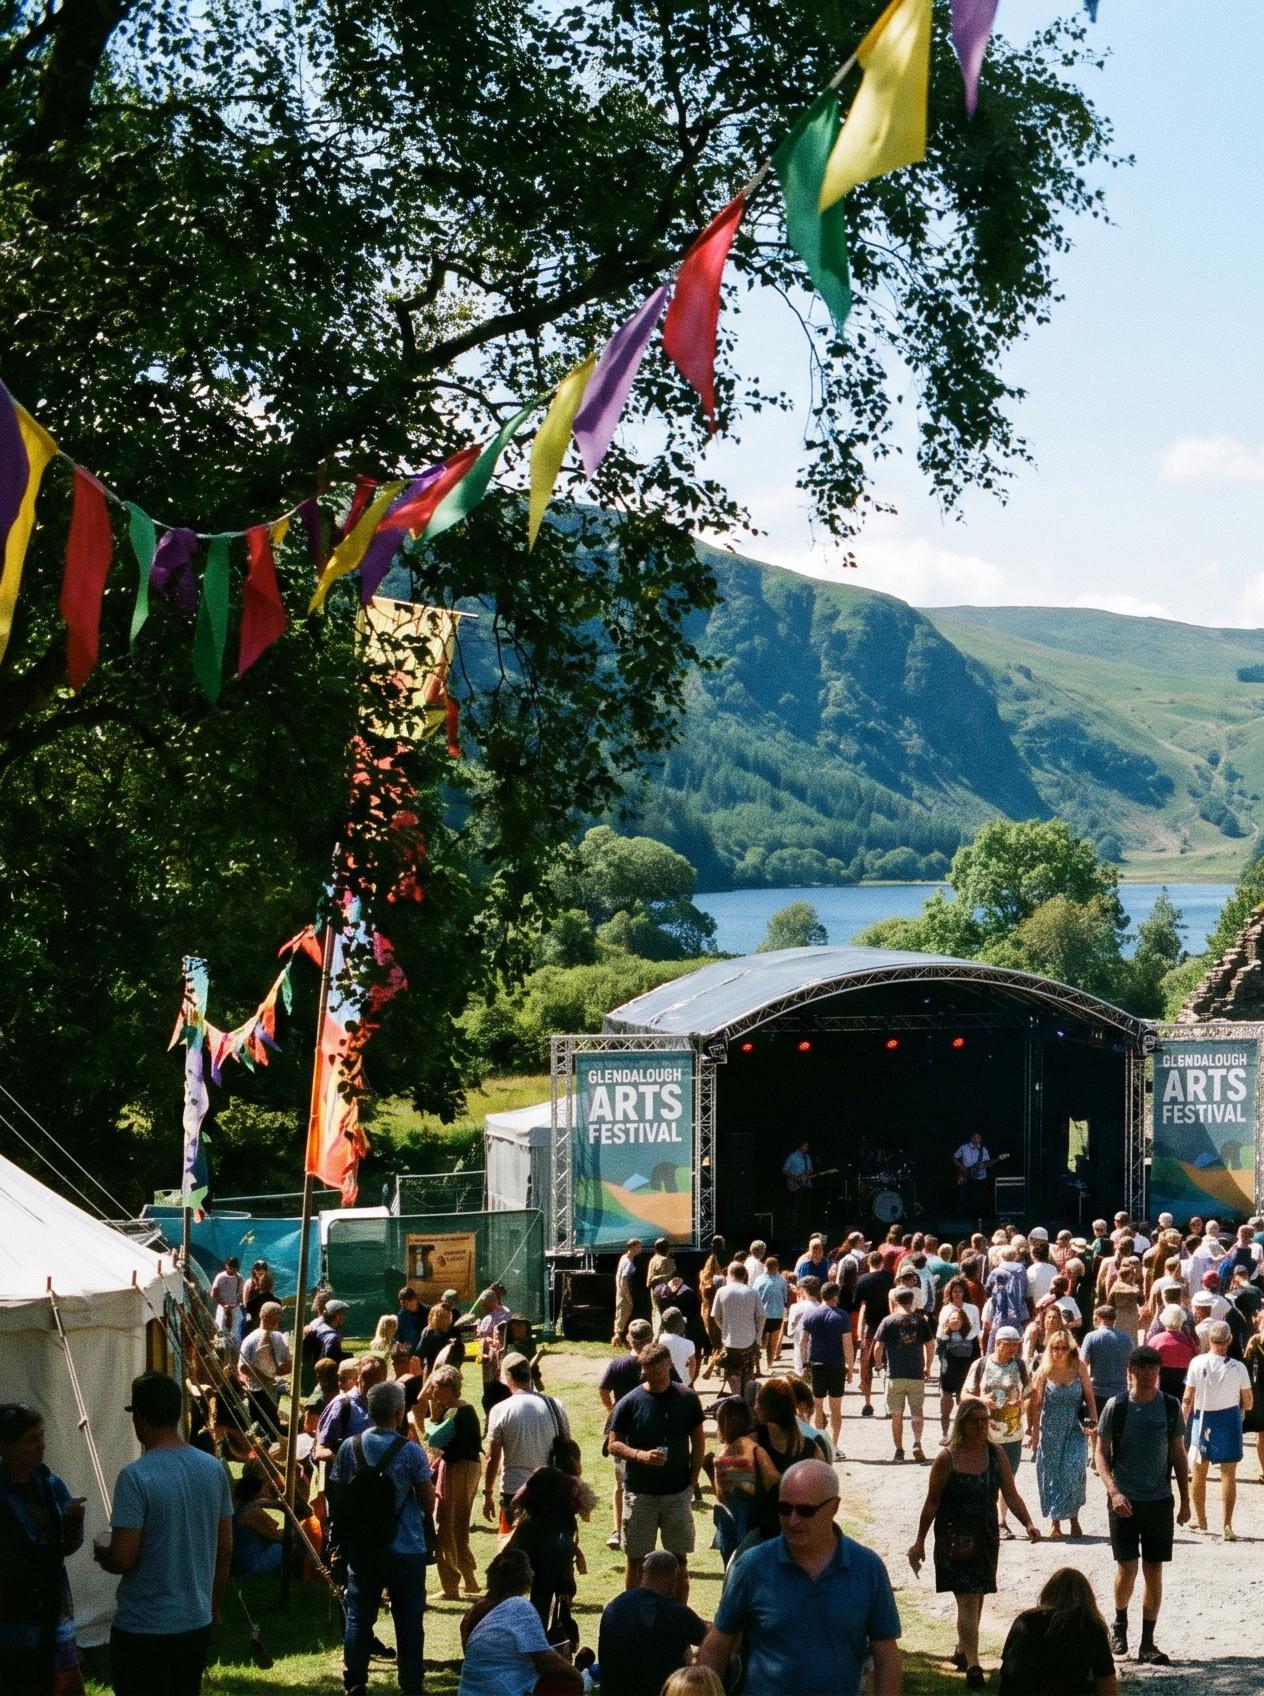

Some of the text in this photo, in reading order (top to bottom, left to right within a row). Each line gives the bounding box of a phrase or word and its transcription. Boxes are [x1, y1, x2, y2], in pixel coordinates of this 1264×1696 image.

[1163, 1054, 1247, 1068] GLENDALOUGH
[588, 1068, 682, 1084] GLENDALOUGH
[1163, 1068, 1247, 1102] ARTS
[588, 1084, 683, 1121] ARTS
[1162, 1103, 1246, 1124] FESTIVAL
[588, 1122, 682, 1144] FESTIVAL
